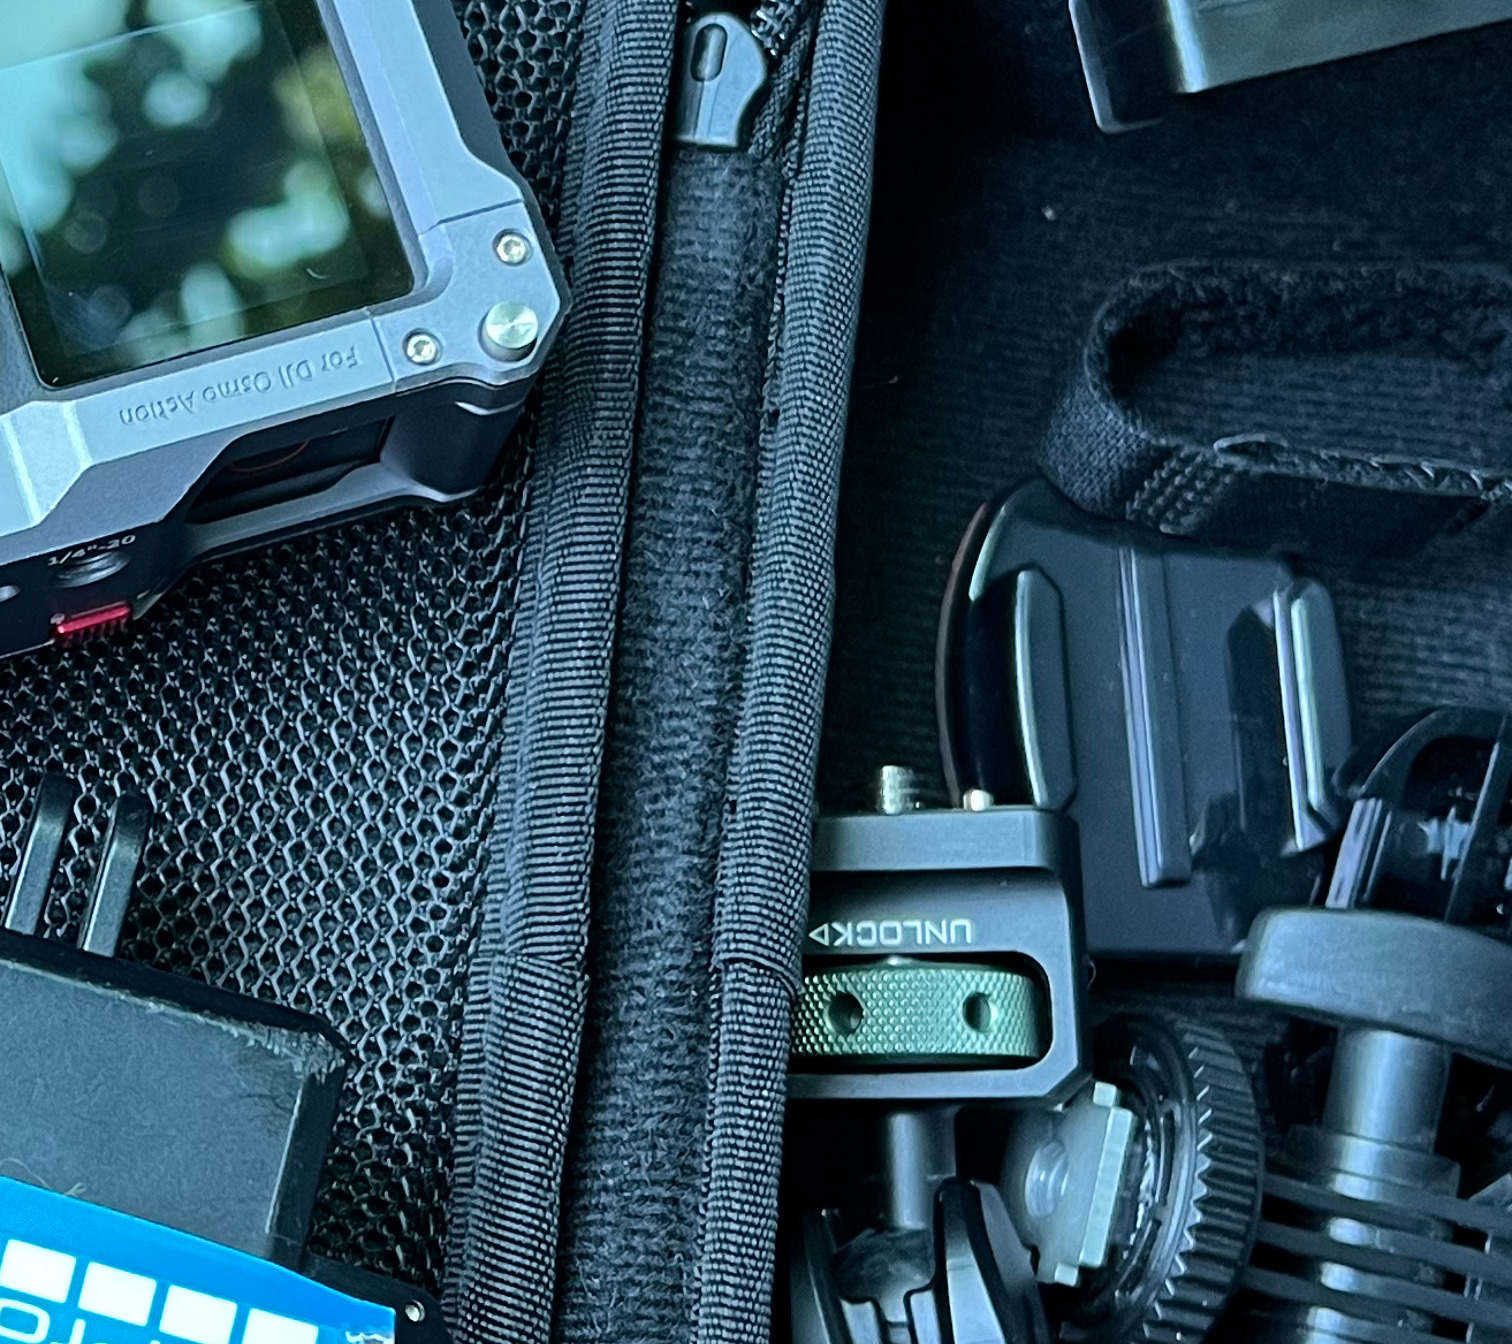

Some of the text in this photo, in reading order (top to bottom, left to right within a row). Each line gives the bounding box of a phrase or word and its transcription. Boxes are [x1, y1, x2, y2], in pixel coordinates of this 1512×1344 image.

[118, 346, 360, 426] For DJI Osmo Action
[832, 918, 973, 947] UNLOCK
